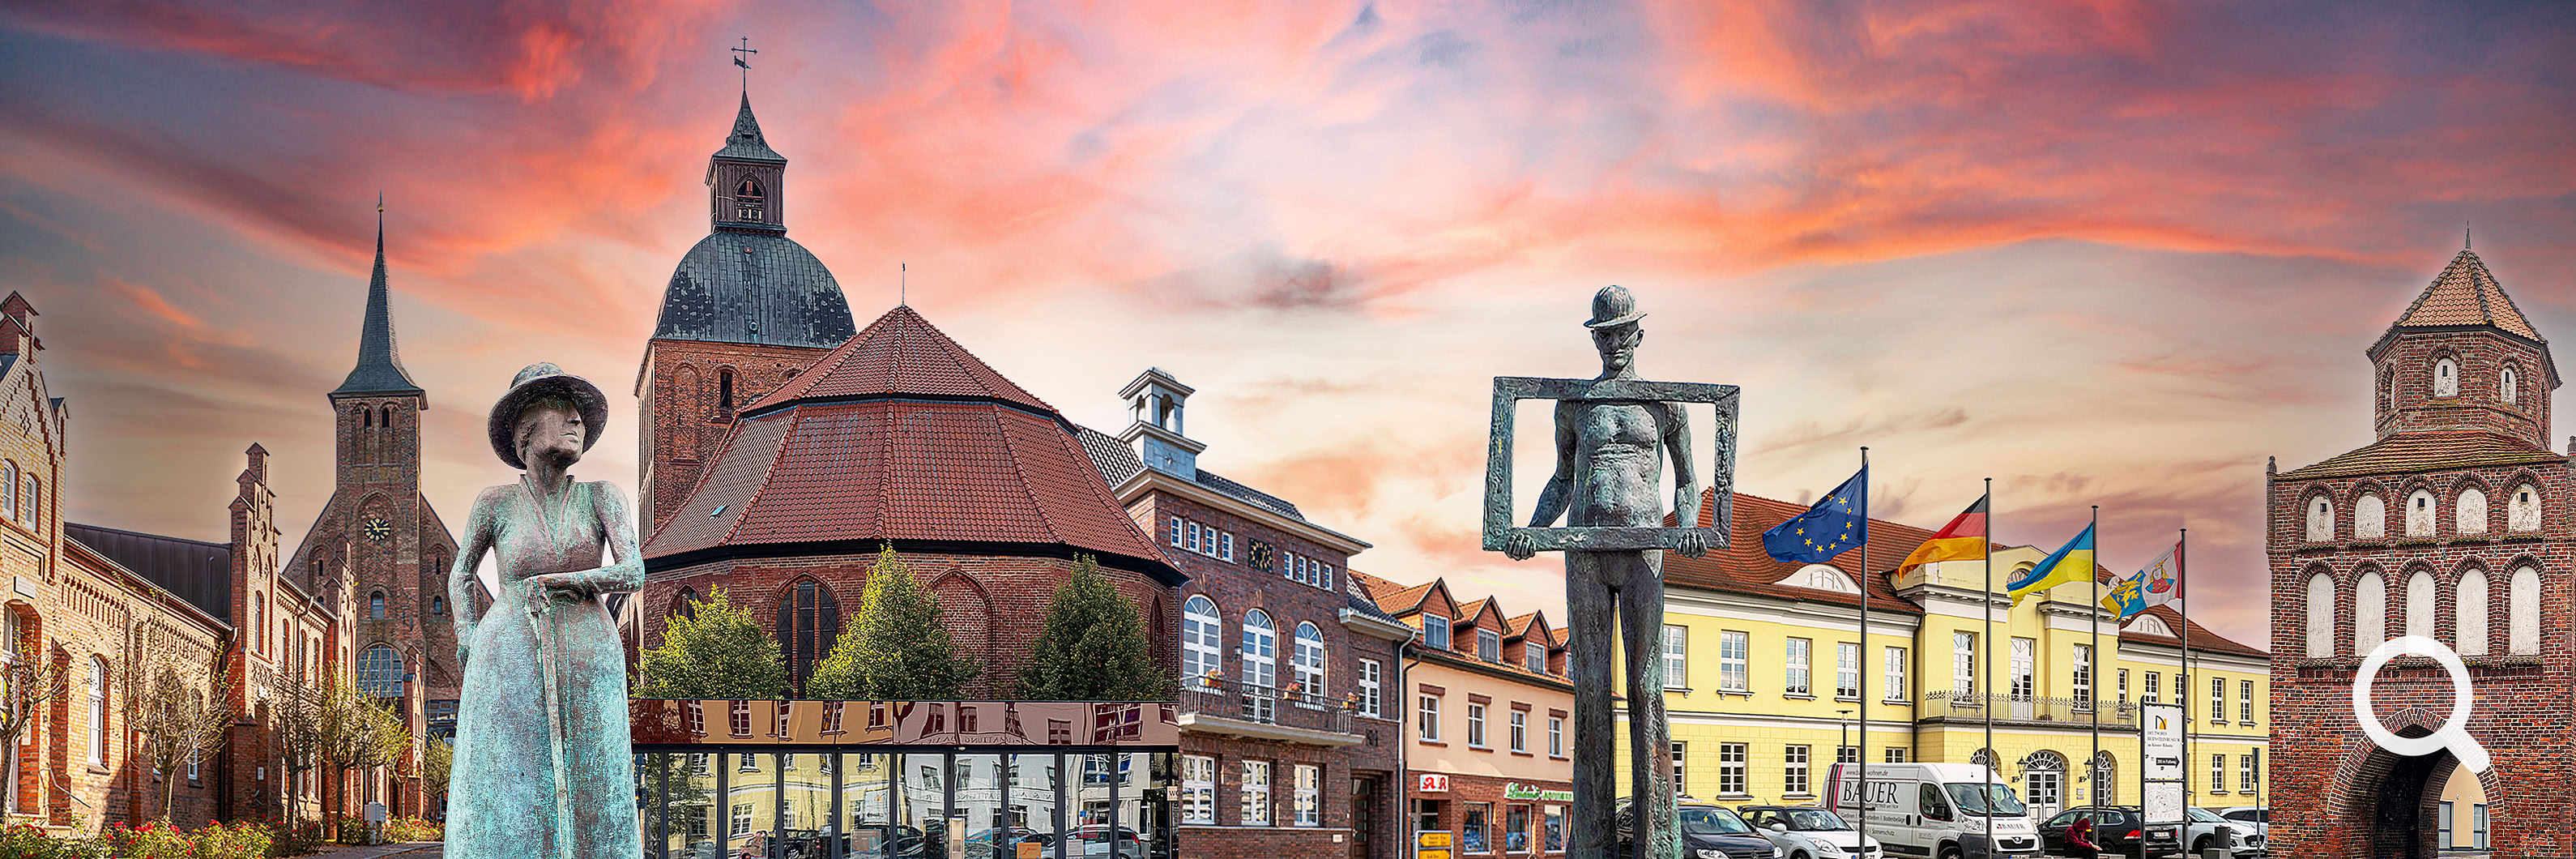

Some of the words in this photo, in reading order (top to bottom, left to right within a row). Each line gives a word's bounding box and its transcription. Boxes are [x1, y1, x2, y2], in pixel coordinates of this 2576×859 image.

[1842, 780, 1899, 804] BAUER
[1883, 815, 1905, 824] Bodenbeläge
[1872, 828, 1895, 836] Sonnenschutz
